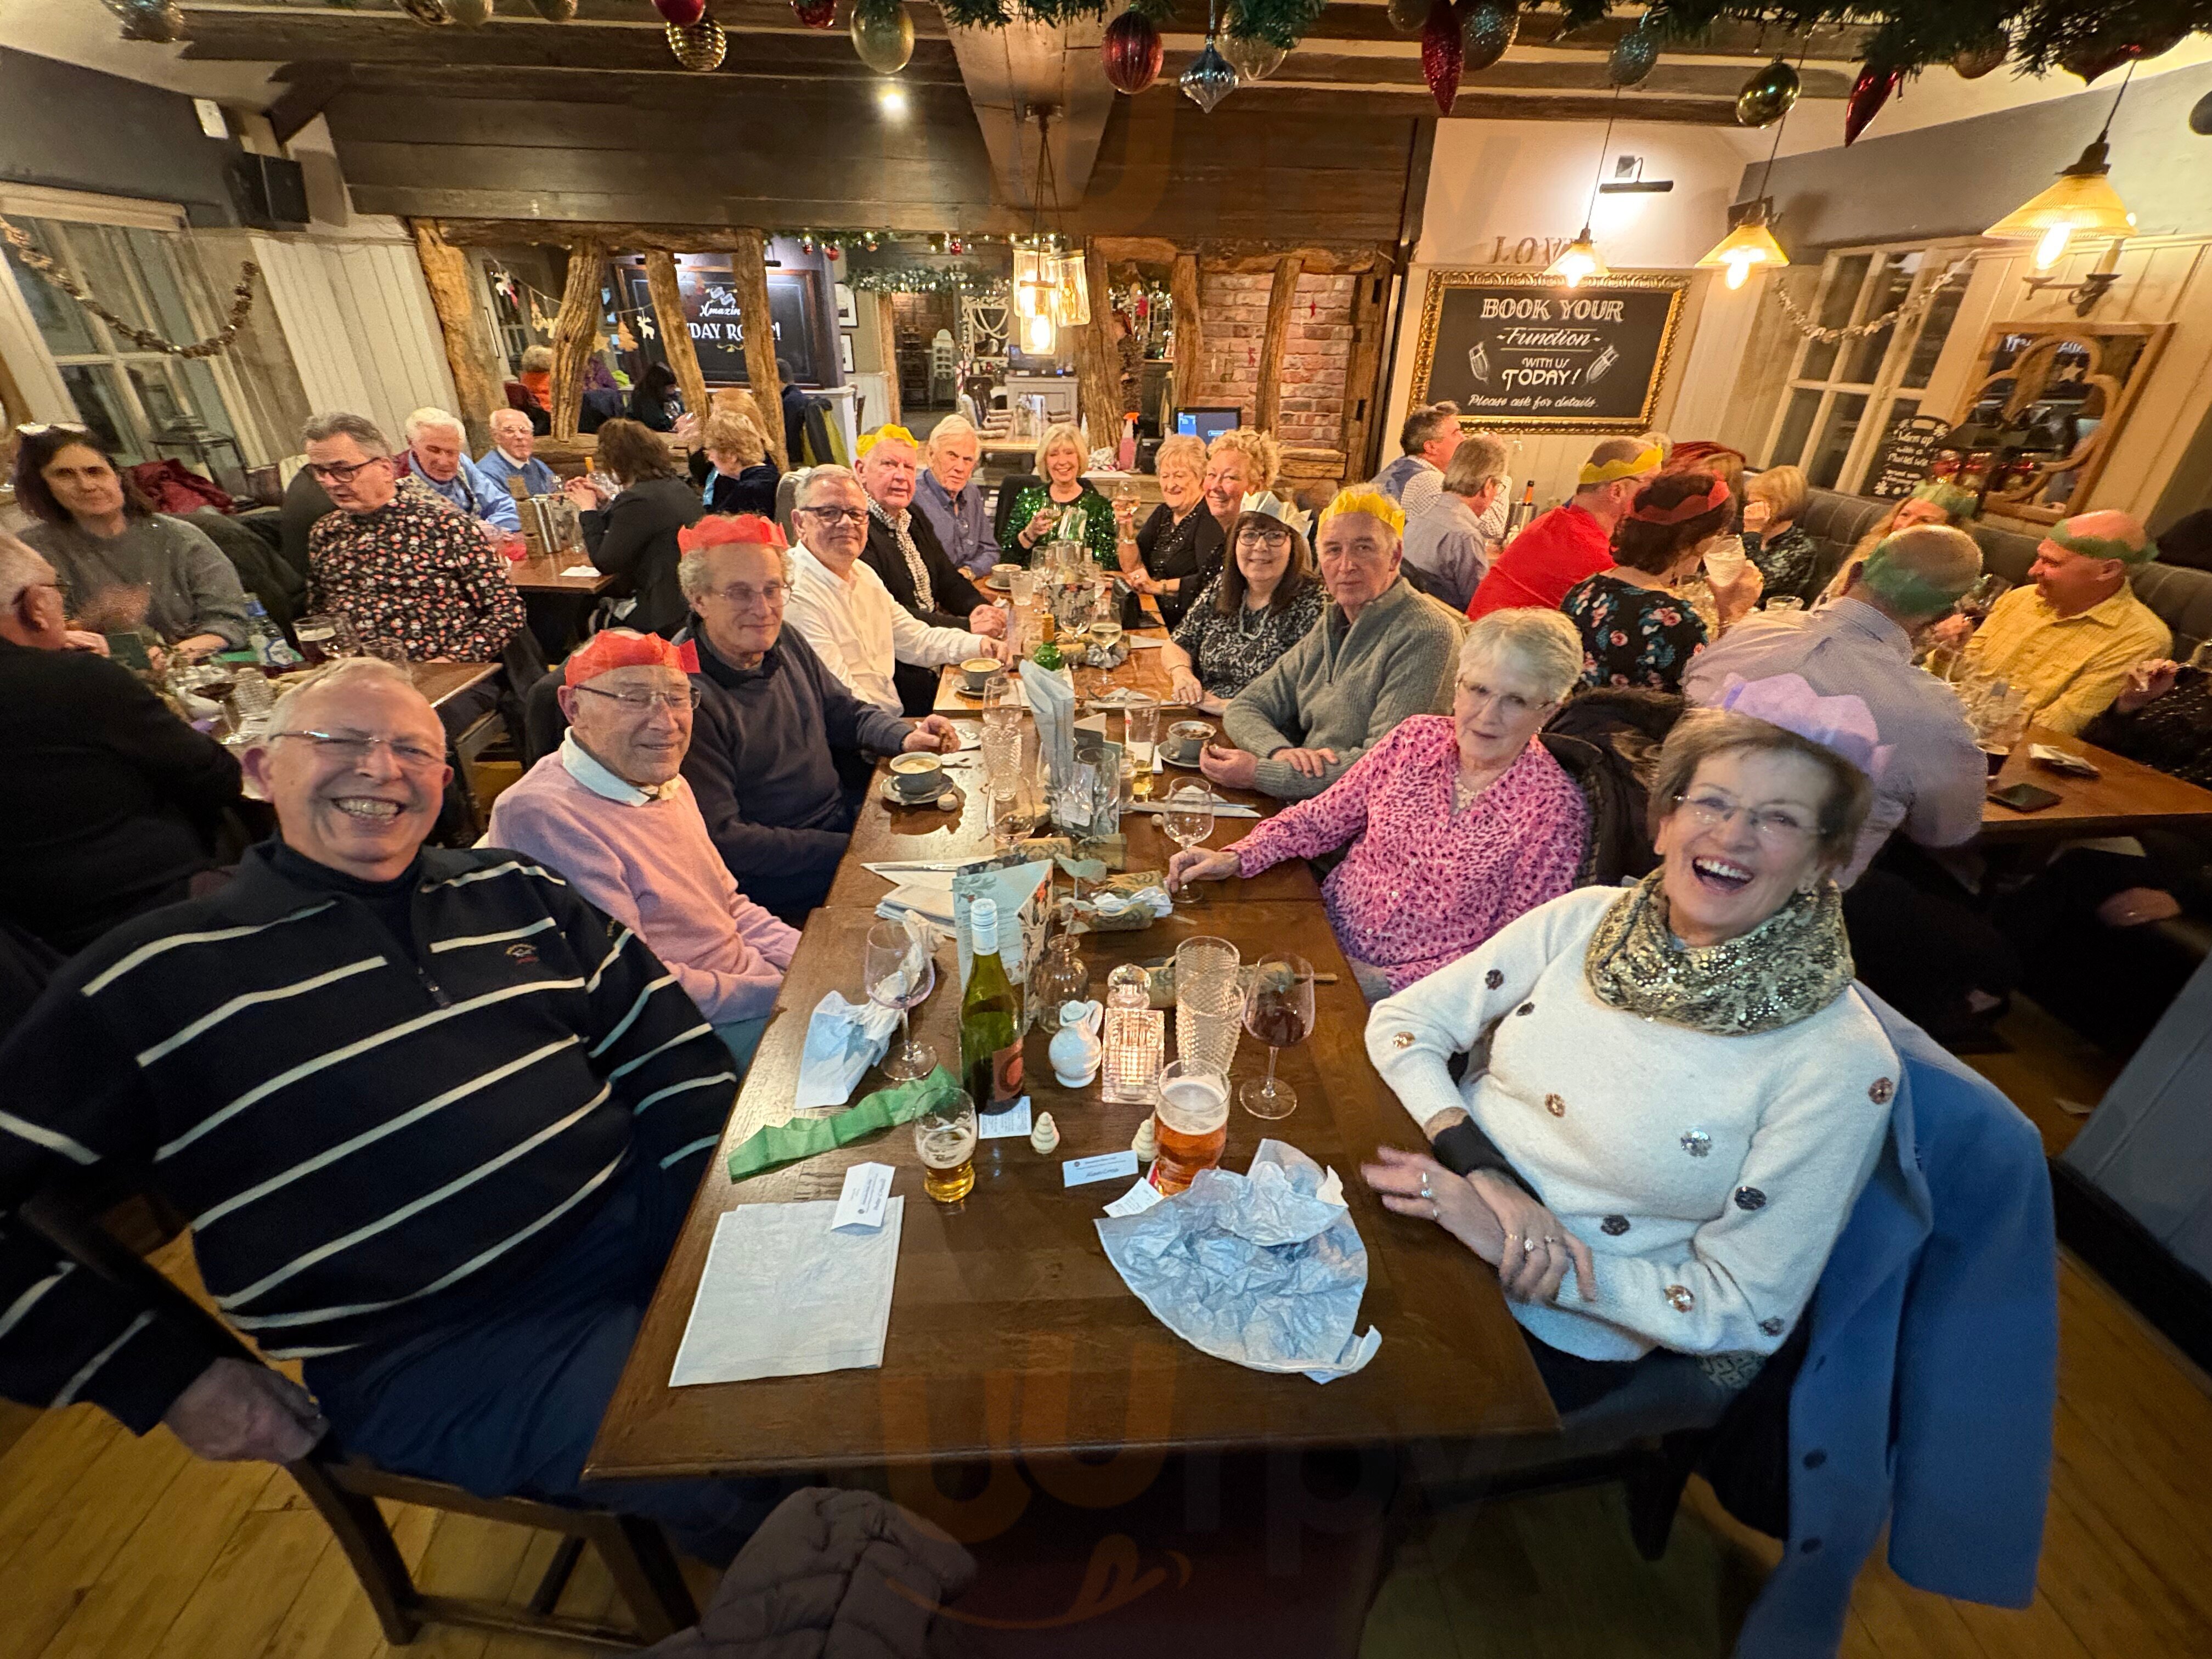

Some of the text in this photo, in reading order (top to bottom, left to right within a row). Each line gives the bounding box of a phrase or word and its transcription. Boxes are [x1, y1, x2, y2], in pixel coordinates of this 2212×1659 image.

[1479, 298, 1624, 322] BOOK YOUR
[1468, 394, 1508, 407] Please
[1510, 396, 1532, 407] ask
[1532, 396, 1553, 410] for
